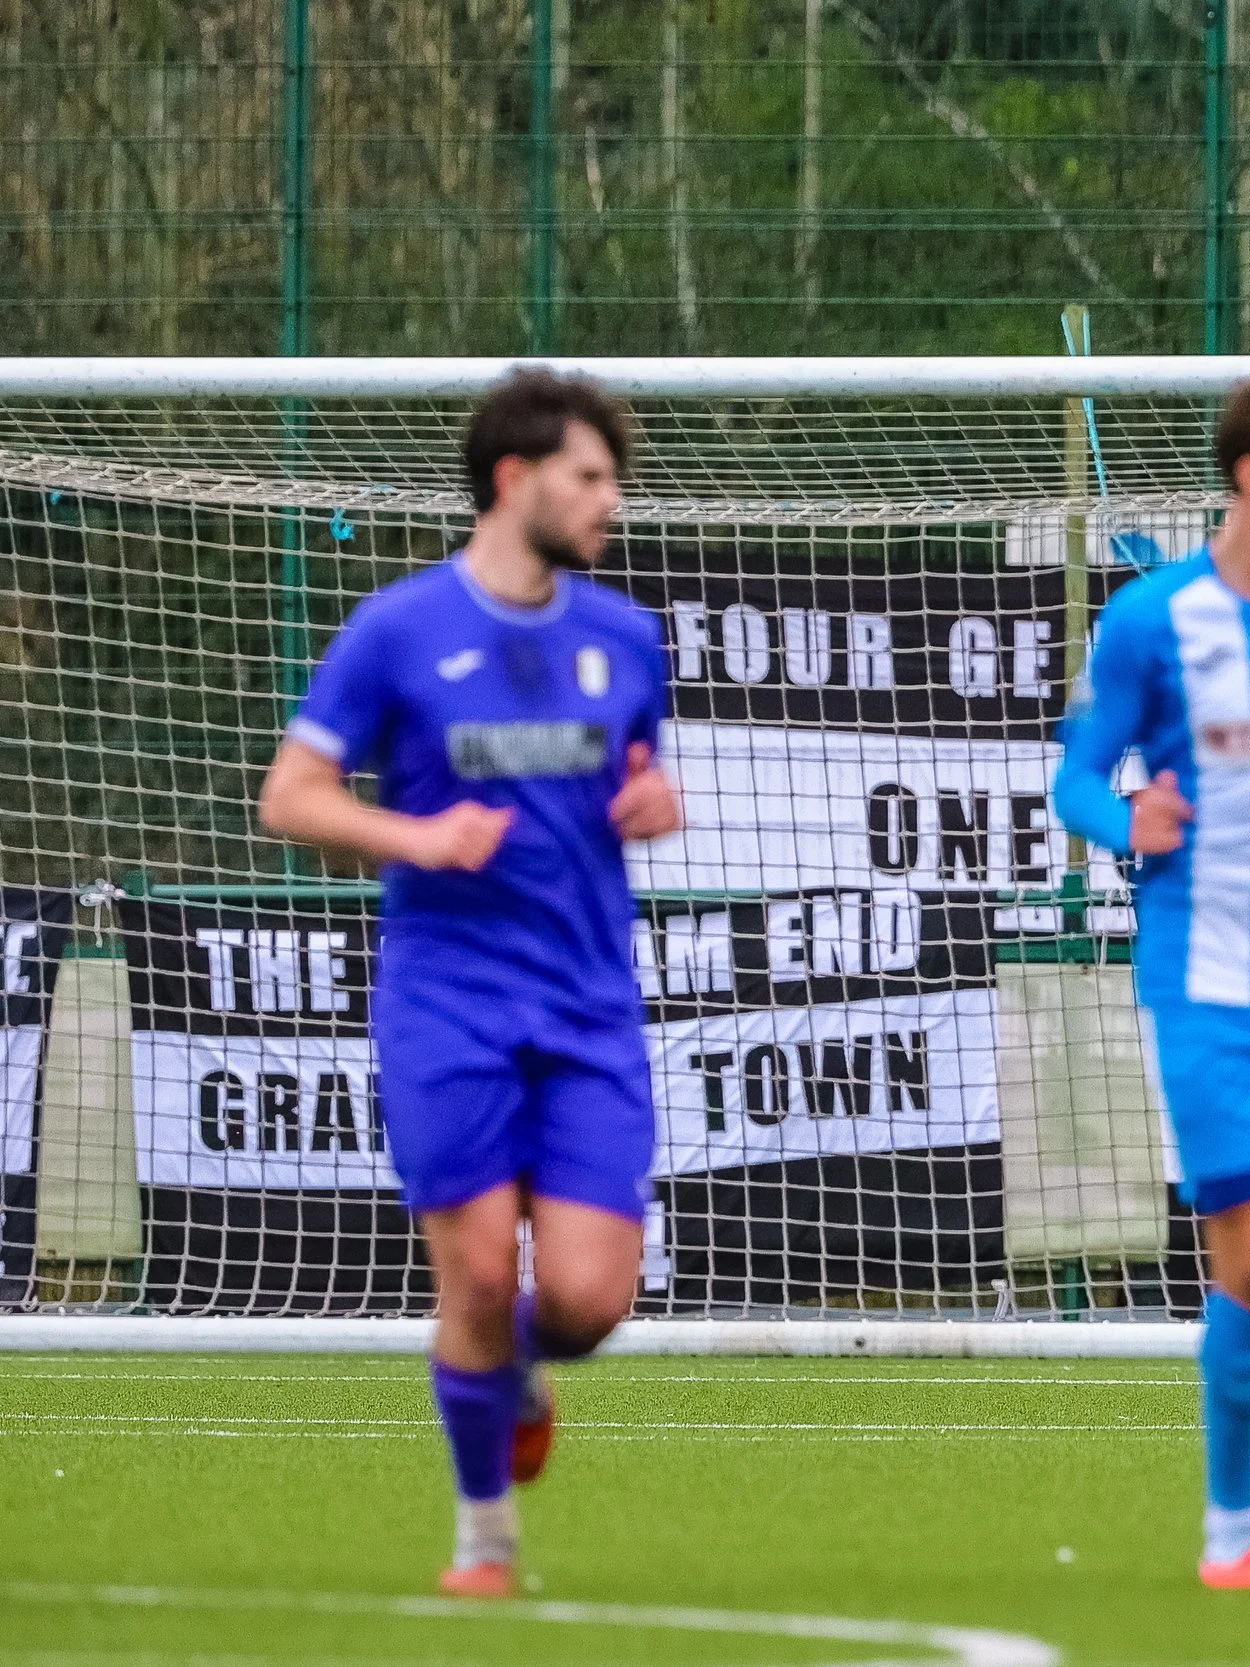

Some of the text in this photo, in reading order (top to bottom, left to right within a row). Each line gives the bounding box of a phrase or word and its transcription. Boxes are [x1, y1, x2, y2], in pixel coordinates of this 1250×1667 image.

[672, 600, 894, 692] FOUR
[866, 782, 1048, 883] ONE
[196, 928, 350, 1012] THE
[767, 889, 921, 984] END
[690, 1031, 930, 1132] TOWN
